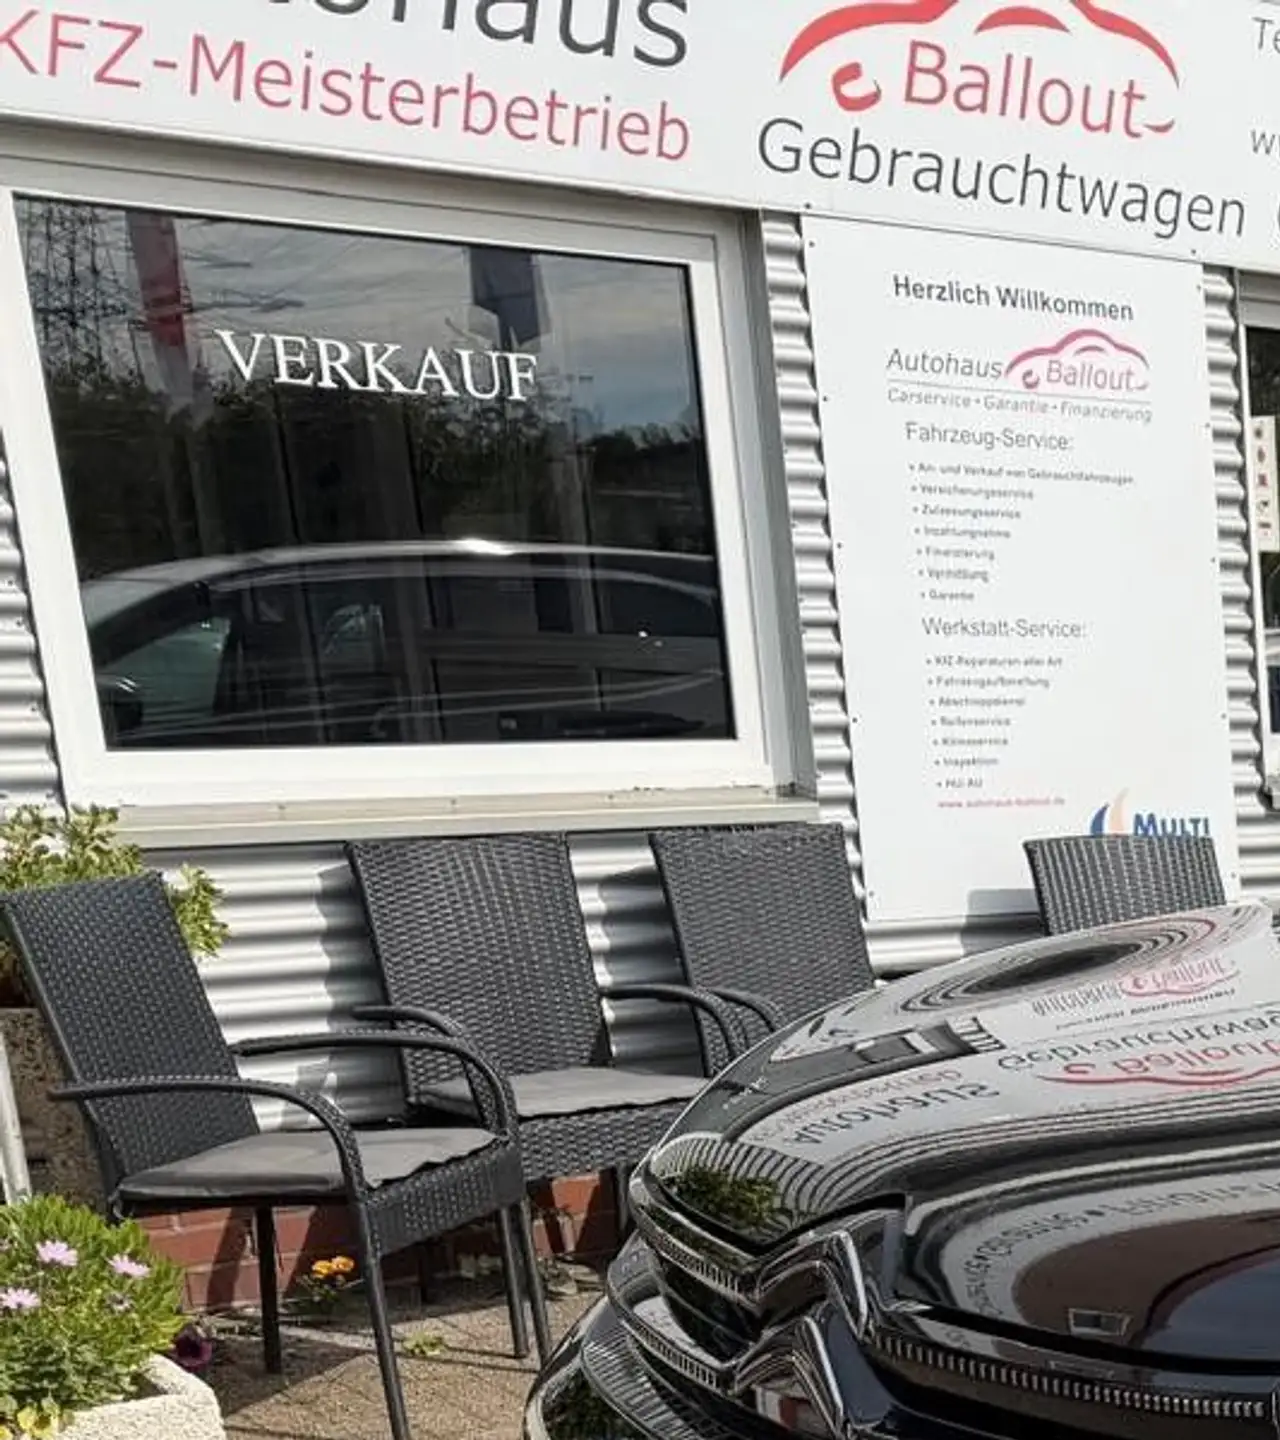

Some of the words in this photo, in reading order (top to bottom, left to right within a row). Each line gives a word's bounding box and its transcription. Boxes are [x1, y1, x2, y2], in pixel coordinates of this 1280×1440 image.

[0, 10, 690, 160] KFZ-Meisterbetrieb
[904, 39, 1147, 139] Ballout
[757, 116, 1246, 240] Gebrauchtwagen
[892, 274, 990, 307] Herzlich
[997, 286, 1134, 322] Willkommen
[213, 329, 538, 402] VERKAUF
[885, 348, 1002, 380] Autohaus
[1045, 359, 1136, 392] Ballout
[887, 387, 971, 408] Carservice
[983, 395, 1050, 416] Garantie
[1060, 401, 1153, 424] Finanzierung
[905, 421, 1074, 452] Fahrzeug-Service:
[921, 616, 1087, 639] Werkstatt-Service:
